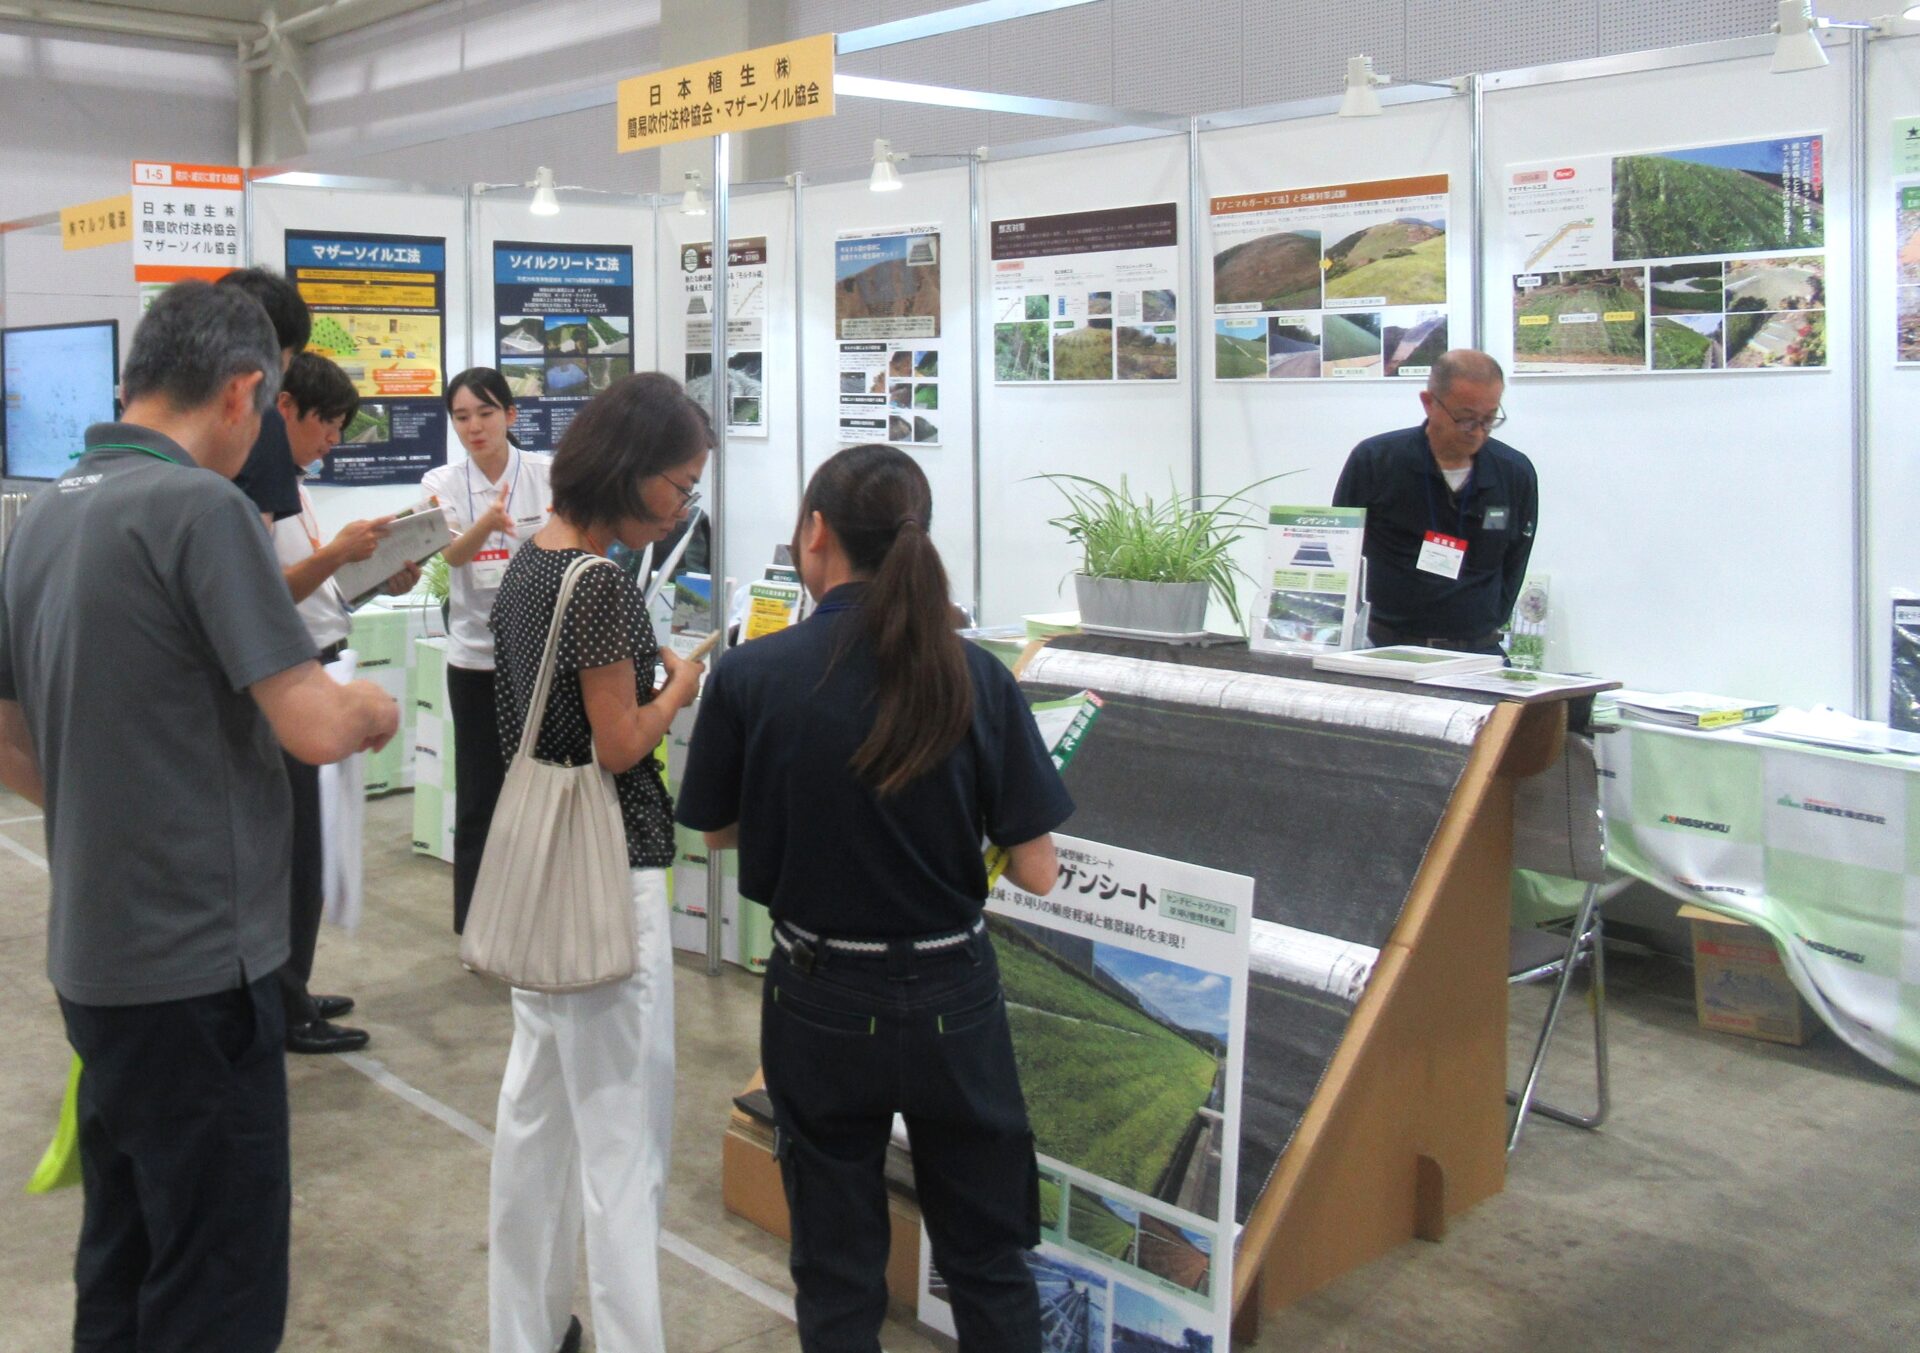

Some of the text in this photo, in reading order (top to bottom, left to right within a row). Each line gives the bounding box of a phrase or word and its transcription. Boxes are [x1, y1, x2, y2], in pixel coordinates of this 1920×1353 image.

[628, 82, 819, 139] 簡易吹付法枠協会・マザーソイル協会
[145, 168, 163, 181] 1-5
[143, 220, 236, 237] 簡易吹付法枠協会
[144, 240, 237, 254] マザーソイル協会
[312, 244, 421, 263] マザーソイル工法
[510, 255, 620, 271] ソイルクリート工法
[1677, 816, 1731, 833] NISSHOKU
[1058, 864, 1156, 910] ゲンシート
